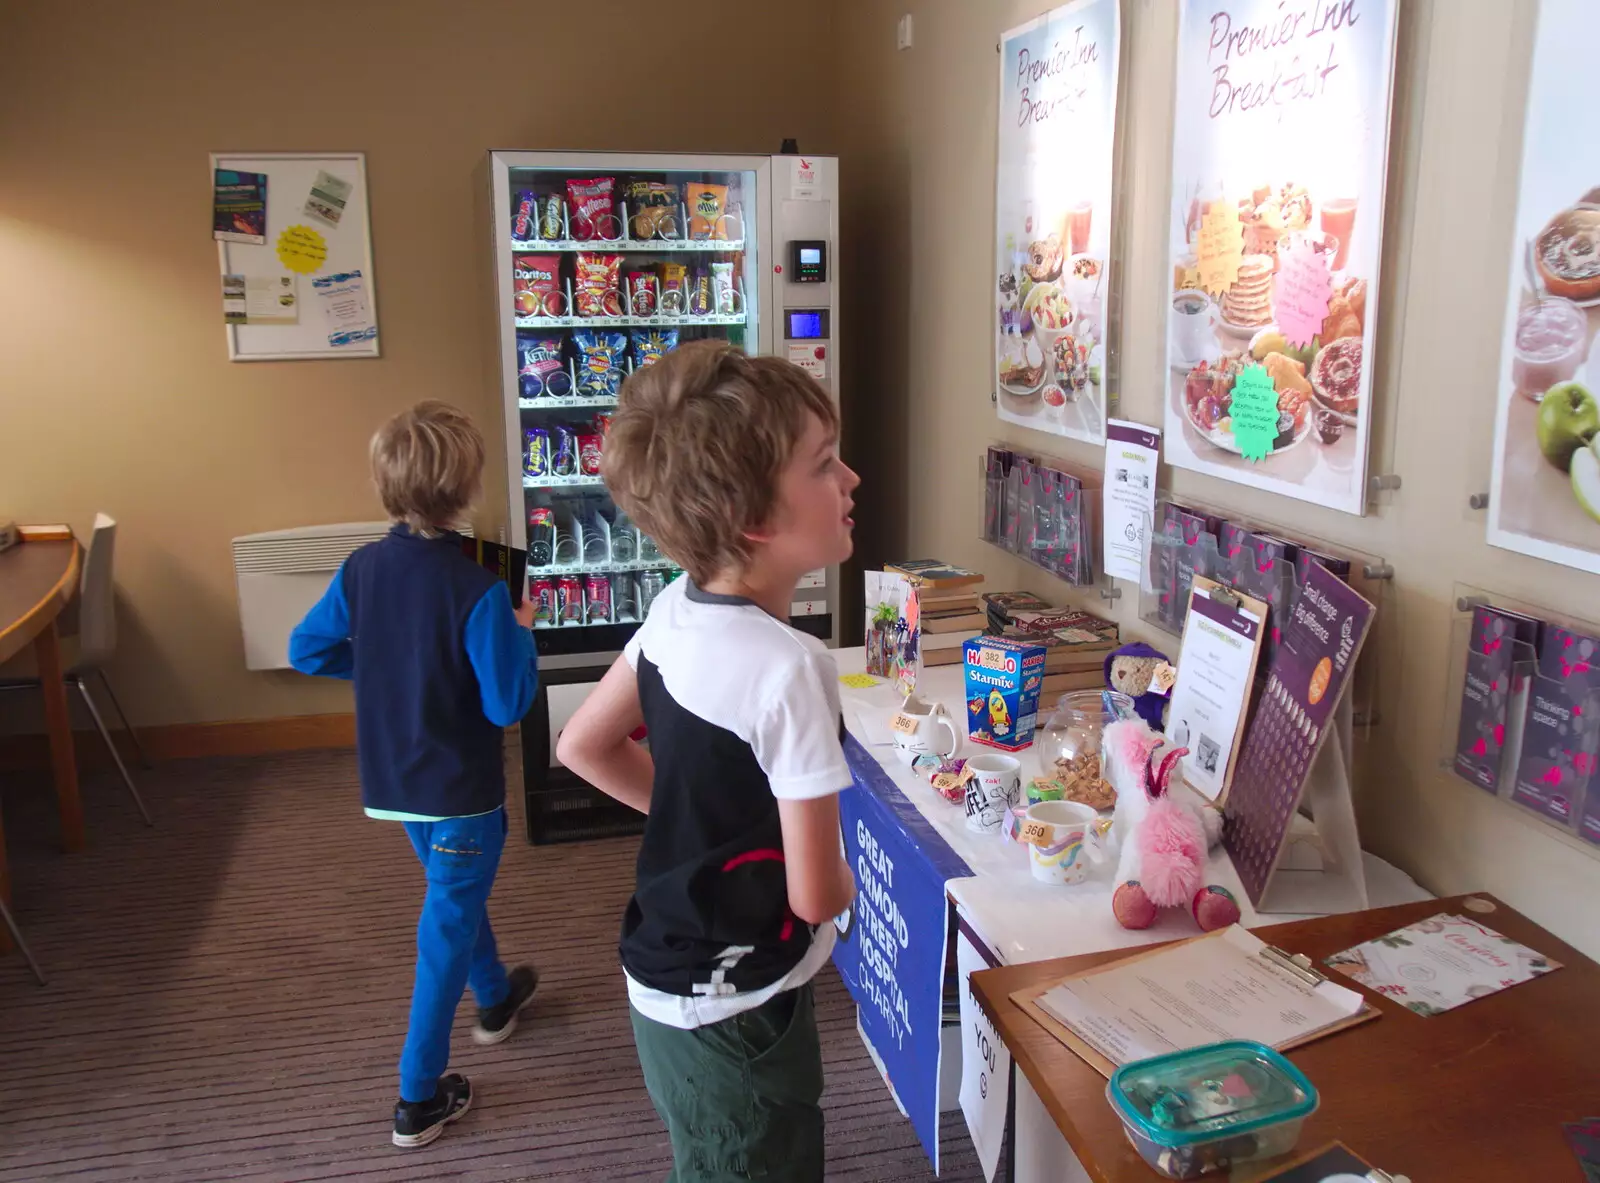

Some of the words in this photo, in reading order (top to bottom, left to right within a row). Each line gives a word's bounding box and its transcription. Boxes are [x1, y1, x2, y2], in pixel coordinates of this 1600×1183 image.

[1207, 1, 1306, 66] Premier
[1306, 0, 1360, 38] Inn
[1017, 42, 1070, 88] Premier
[1070, 25, 1099, 69] Inn
[514, 268, 552, 280] Doritos
[985, 652, 1000, 663] 382
[1022, 654, 1045, 668] HARIBO
[970, 670, 1011, 689] Starmix
[896, 716, 911, 729] 366
[1532, 711, 1558, 728] space
[1536, 696, 1570, 721] Thinking
[1025, 824, 1045, 838] 360
[857, 819, 893, 888] GREAT
[858, 854, 909, 949] ORMOND
[859, 890, 898, 969] STREET
[859, 923, 913, 1036] HOSPITAL
[859, 962, 904, 1051] CHARITY
[974, 1021, 996, 1075] YOU
